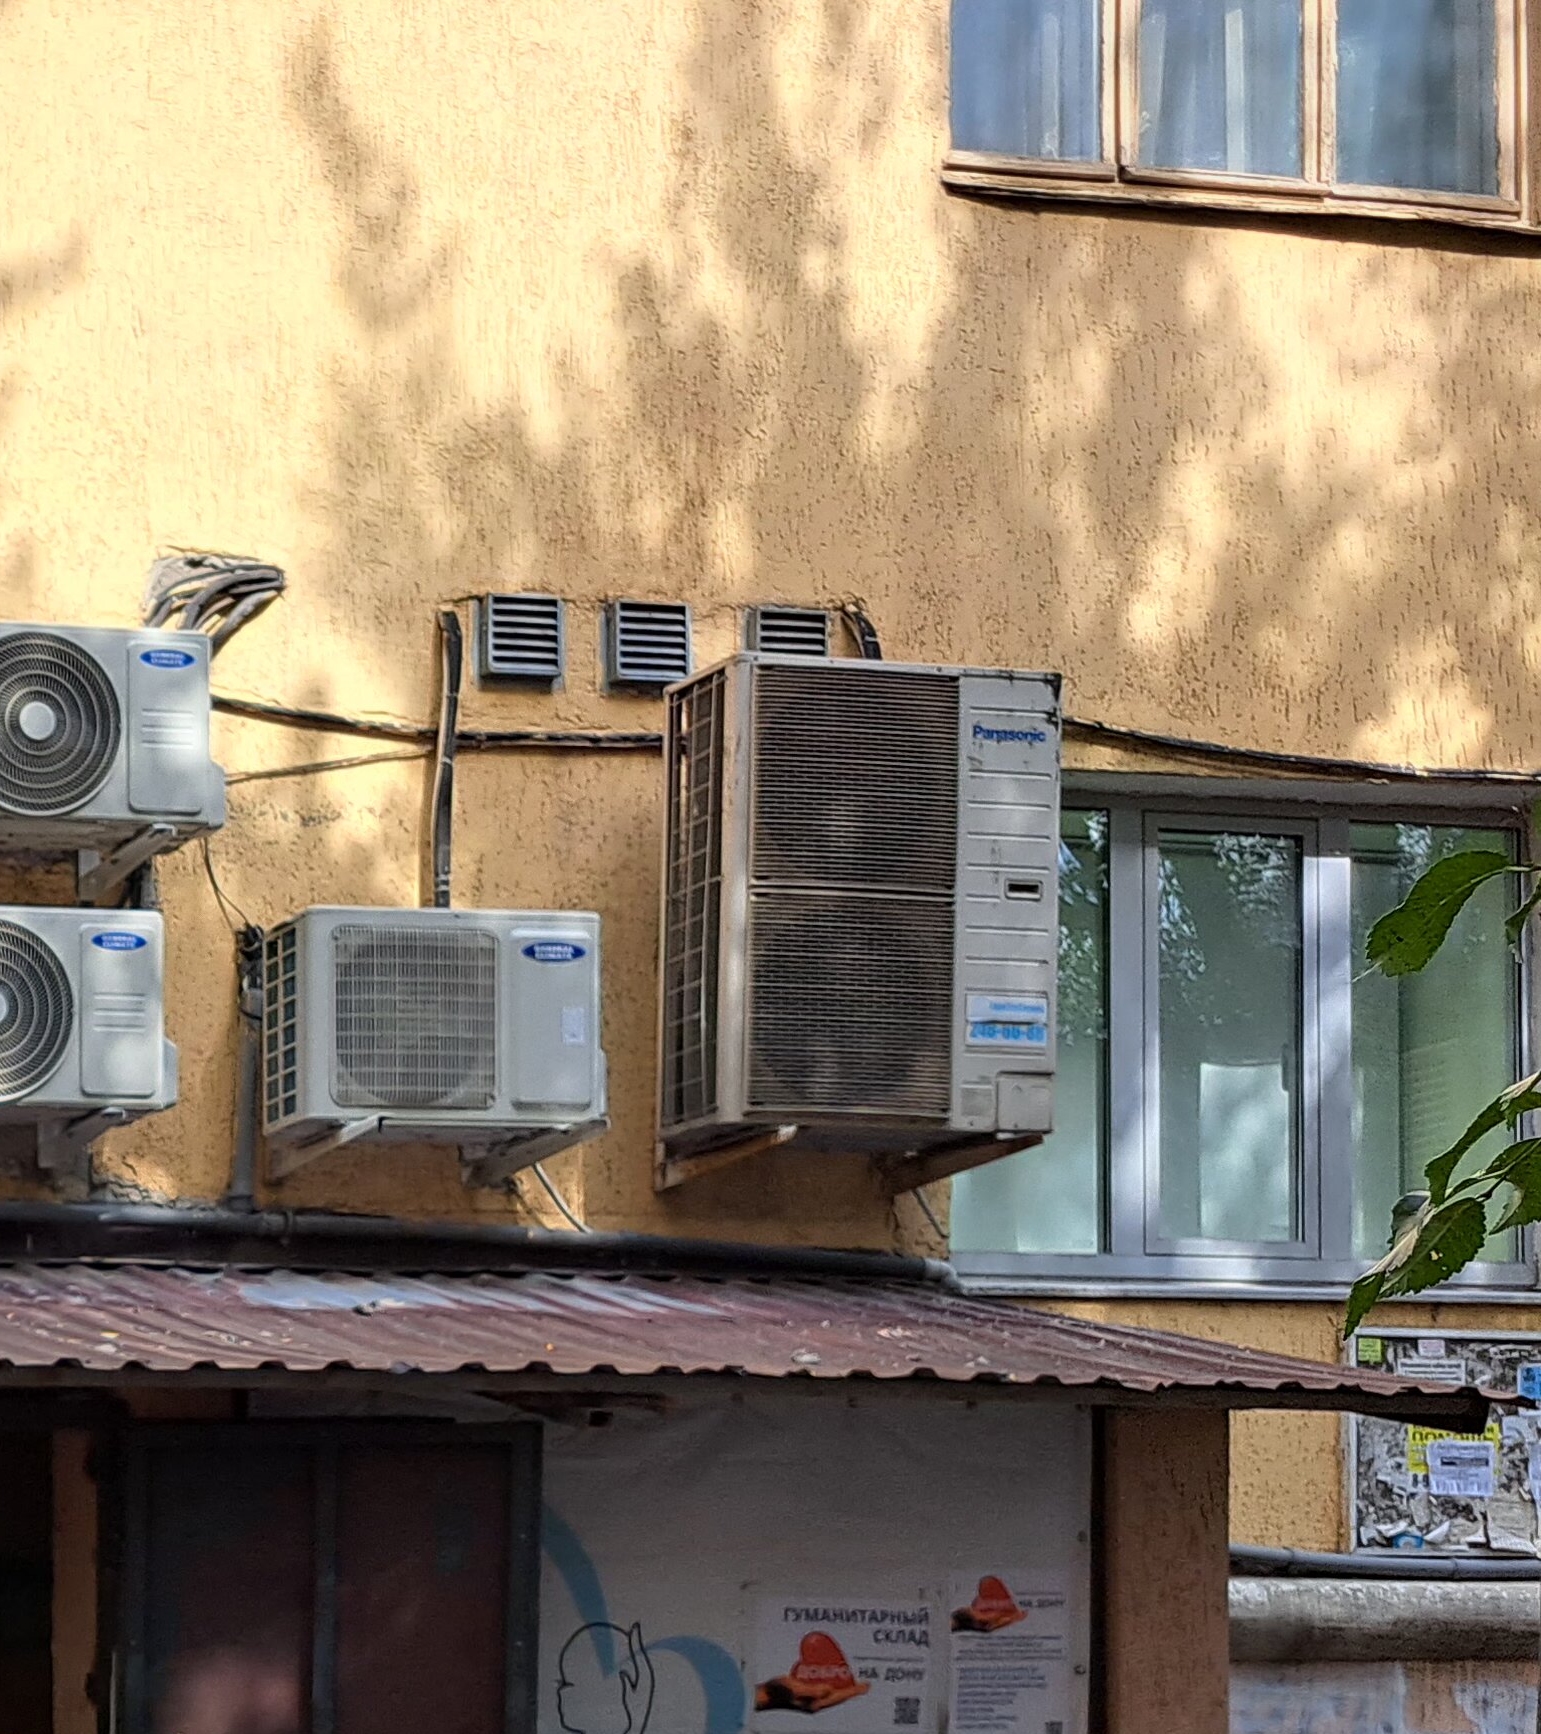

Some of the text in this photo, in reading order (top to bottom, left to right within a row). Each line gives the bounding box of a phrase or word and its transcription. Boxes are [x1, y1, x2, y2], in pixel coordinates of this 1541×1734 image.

[972, 725, 1047, 742] Panasonic
[782, 1606, 929, 1626] ГУМАНИТАРНЫЙ
[872, 1628, 930, 1648] СКЛАД
[858, 1666, 879, 1679] НА
